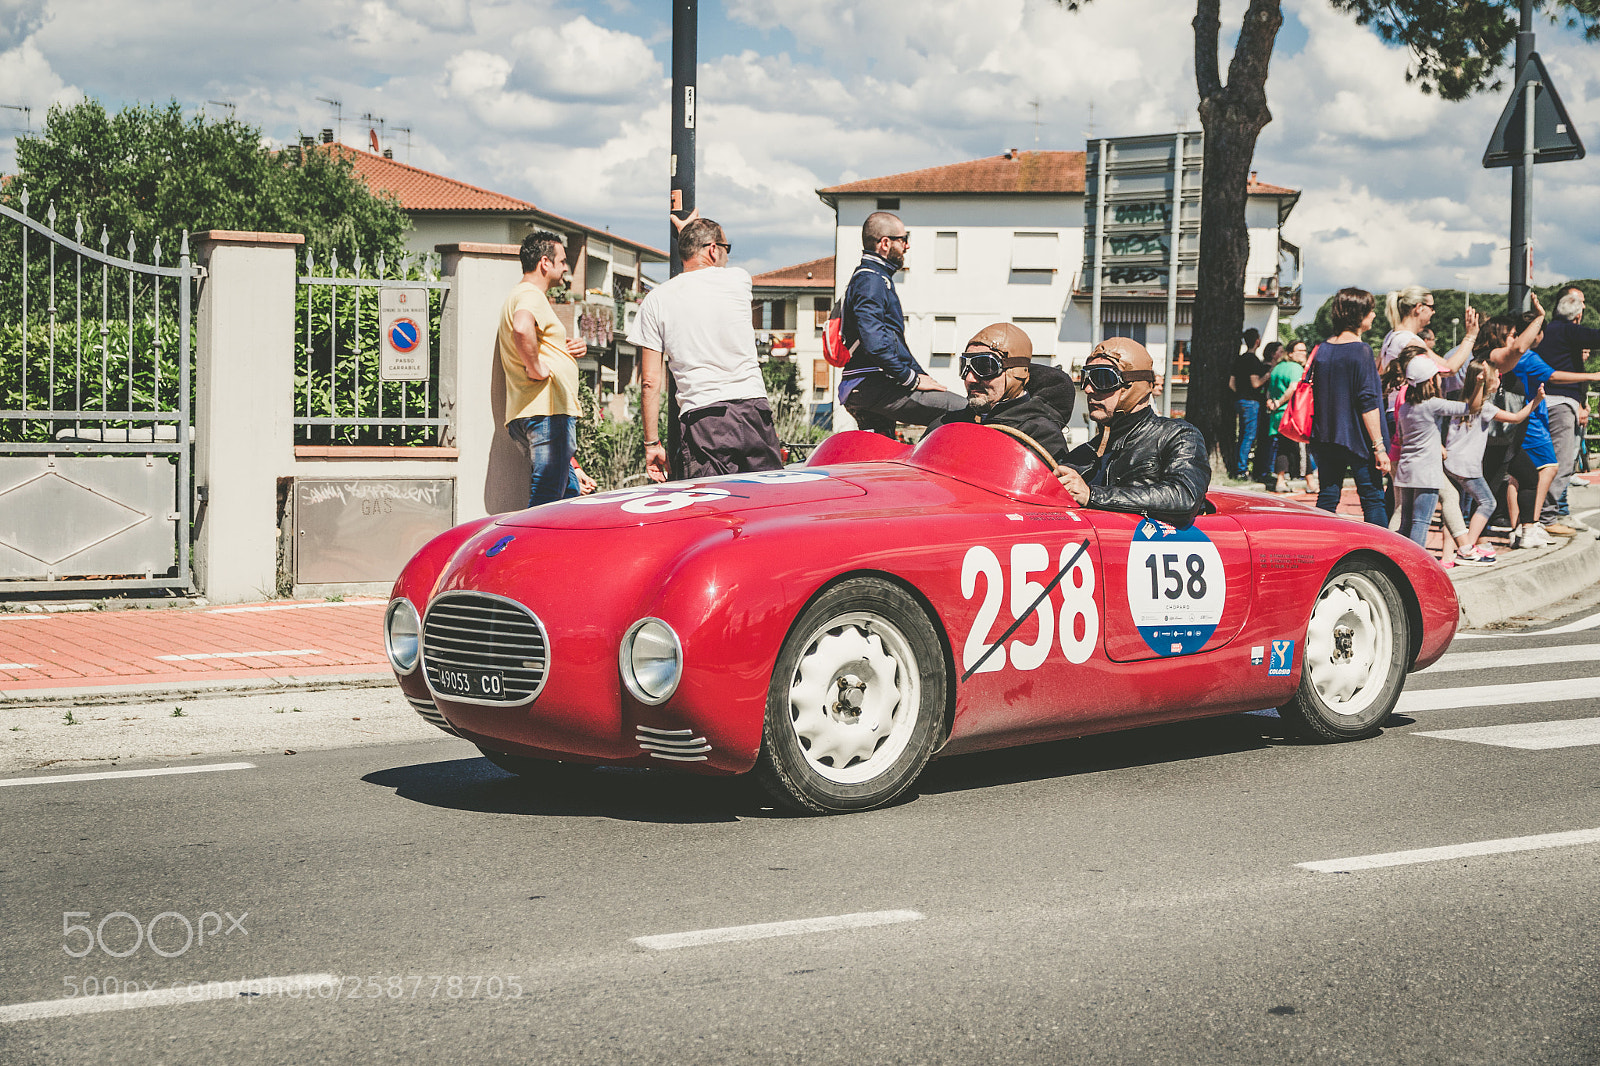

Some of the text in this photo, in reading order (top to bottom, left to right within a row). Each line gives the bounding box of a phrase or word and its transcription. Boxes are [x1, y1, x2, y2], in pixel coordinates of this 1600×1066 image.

[361, 498, 393, 516] GAS
[1145, 553, 1208, 600] 158
[960, 542, 1100, 674] 258
[440, 669, 500, 694] 49053 CO
